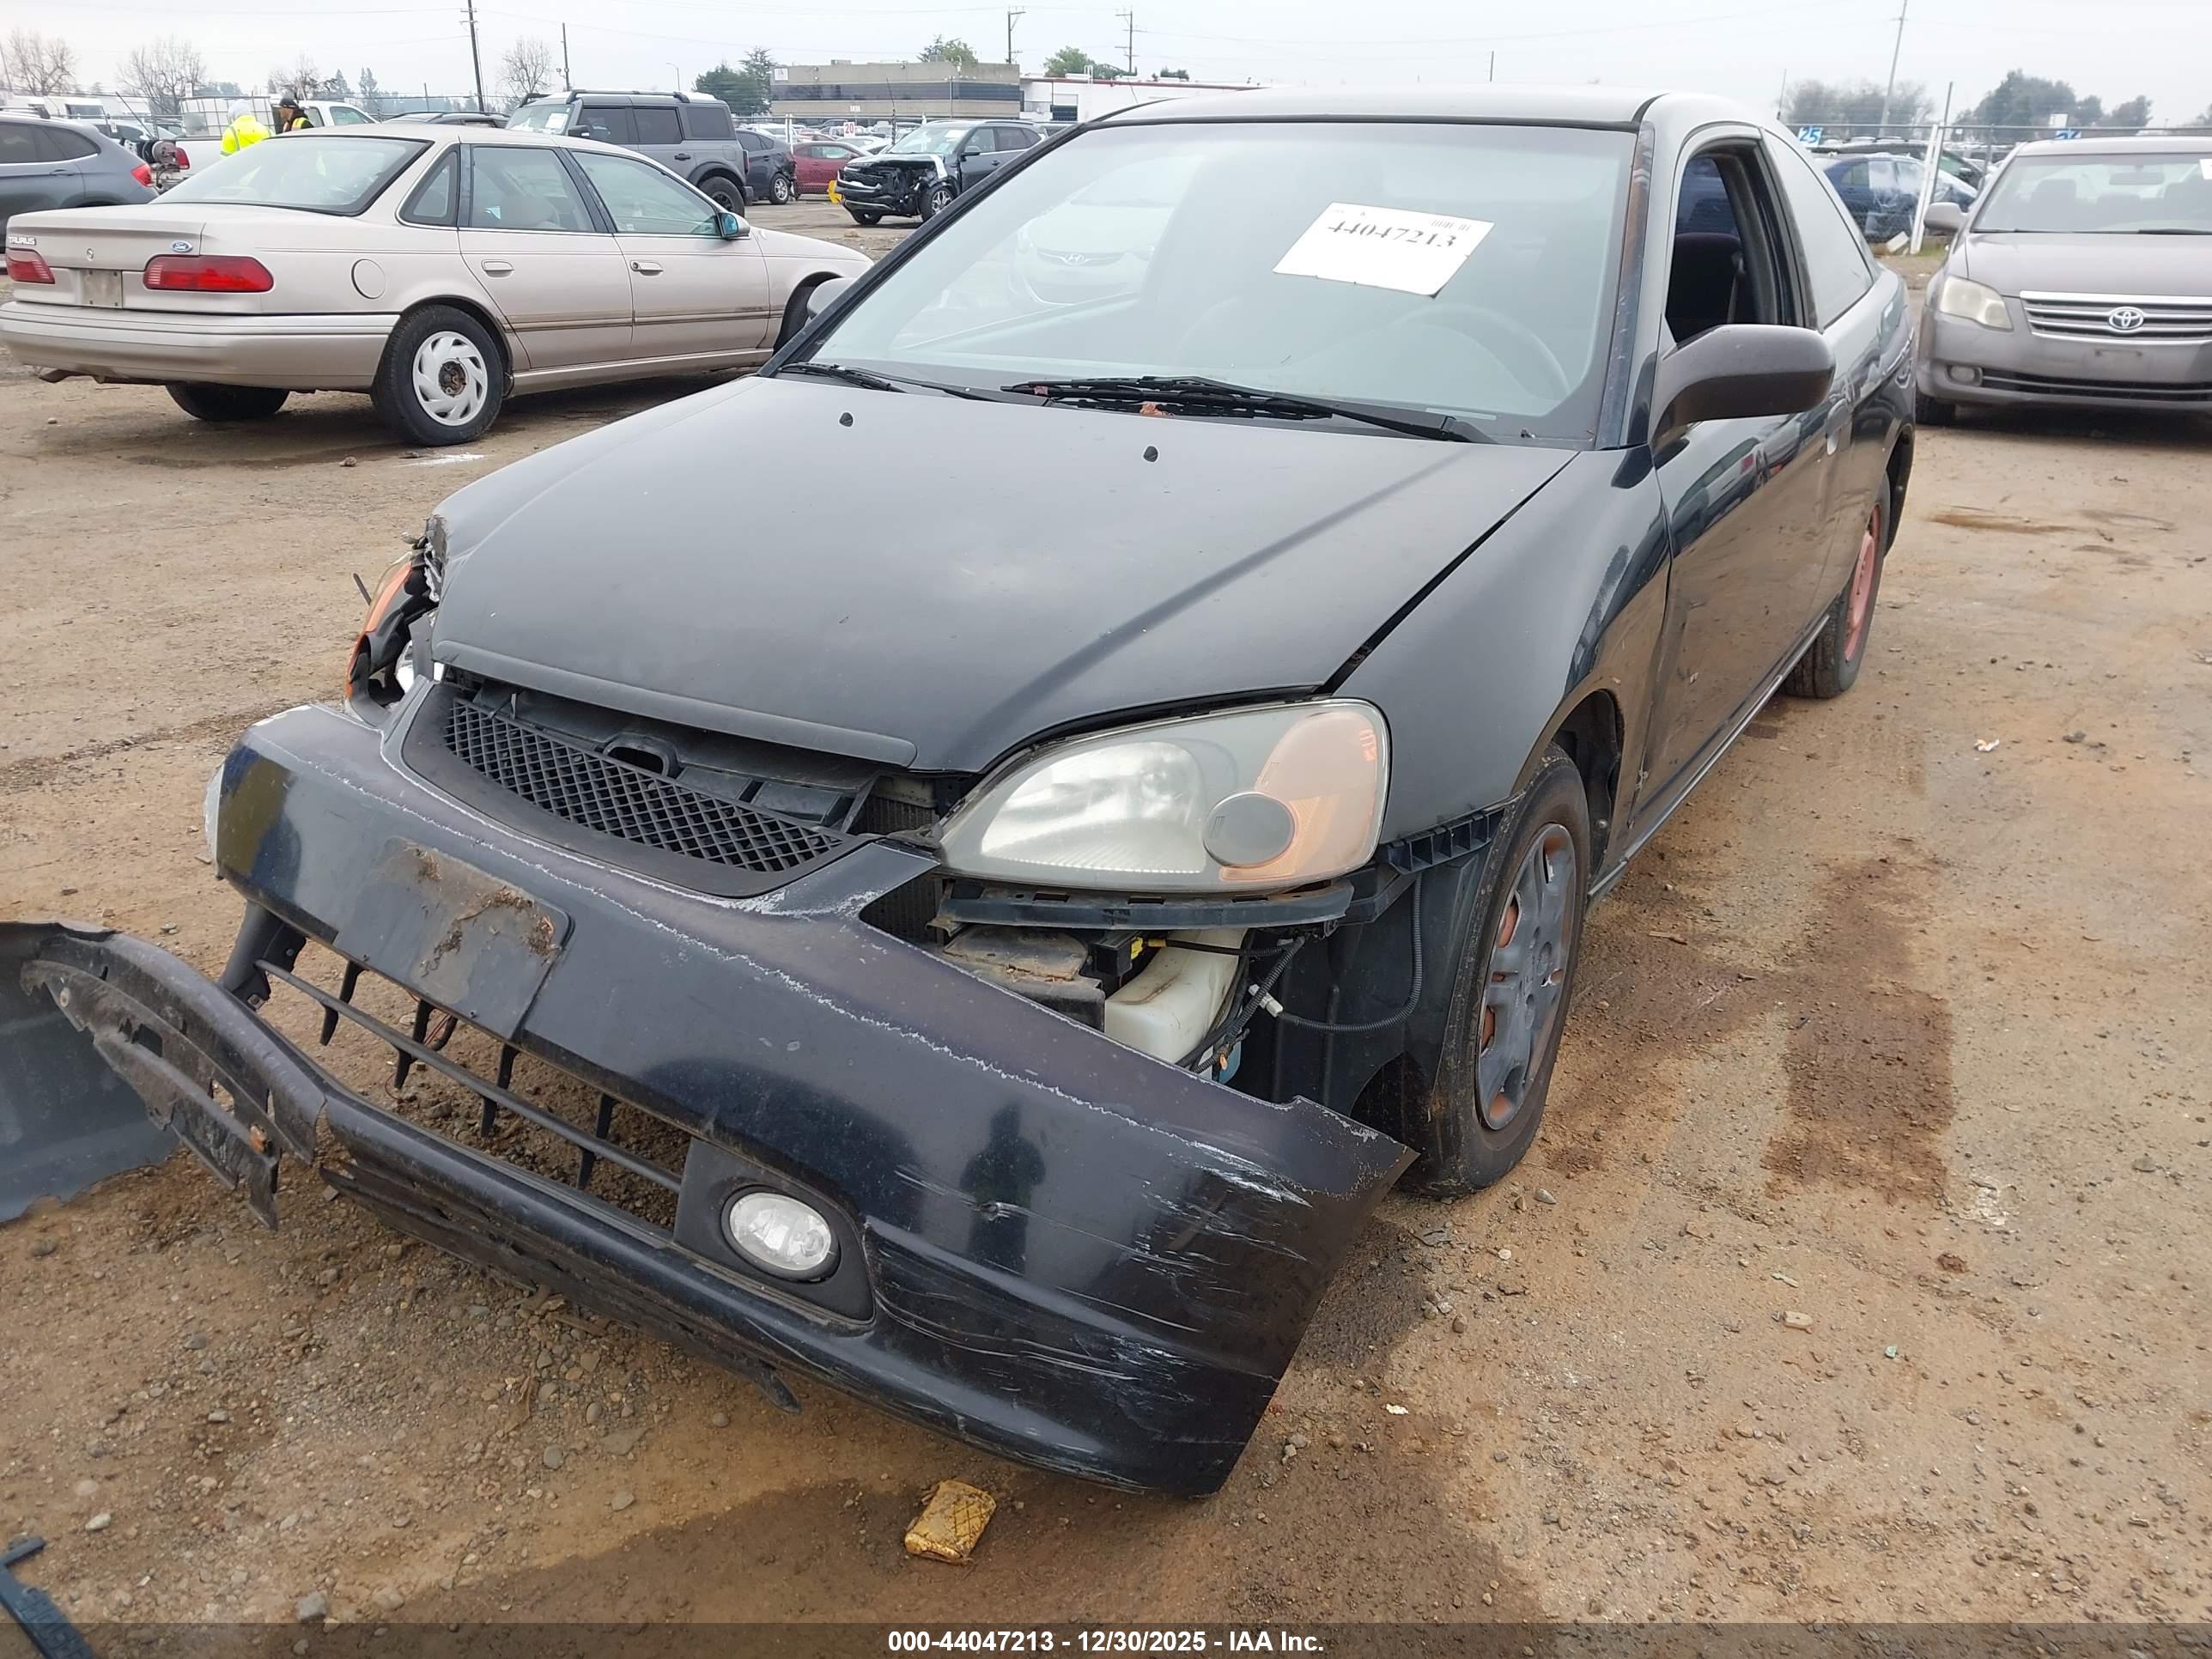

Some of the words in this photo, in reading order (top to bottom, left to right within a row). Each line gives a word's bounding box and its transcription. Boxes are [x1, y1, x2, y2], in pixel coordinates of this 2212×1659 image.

[845, 123, 854, 135] 20
[1799, 126, 1821, 143] 25
[8, 236, 36, 246] TAURUS
[1328, 221, 1457, 247] 44047213
